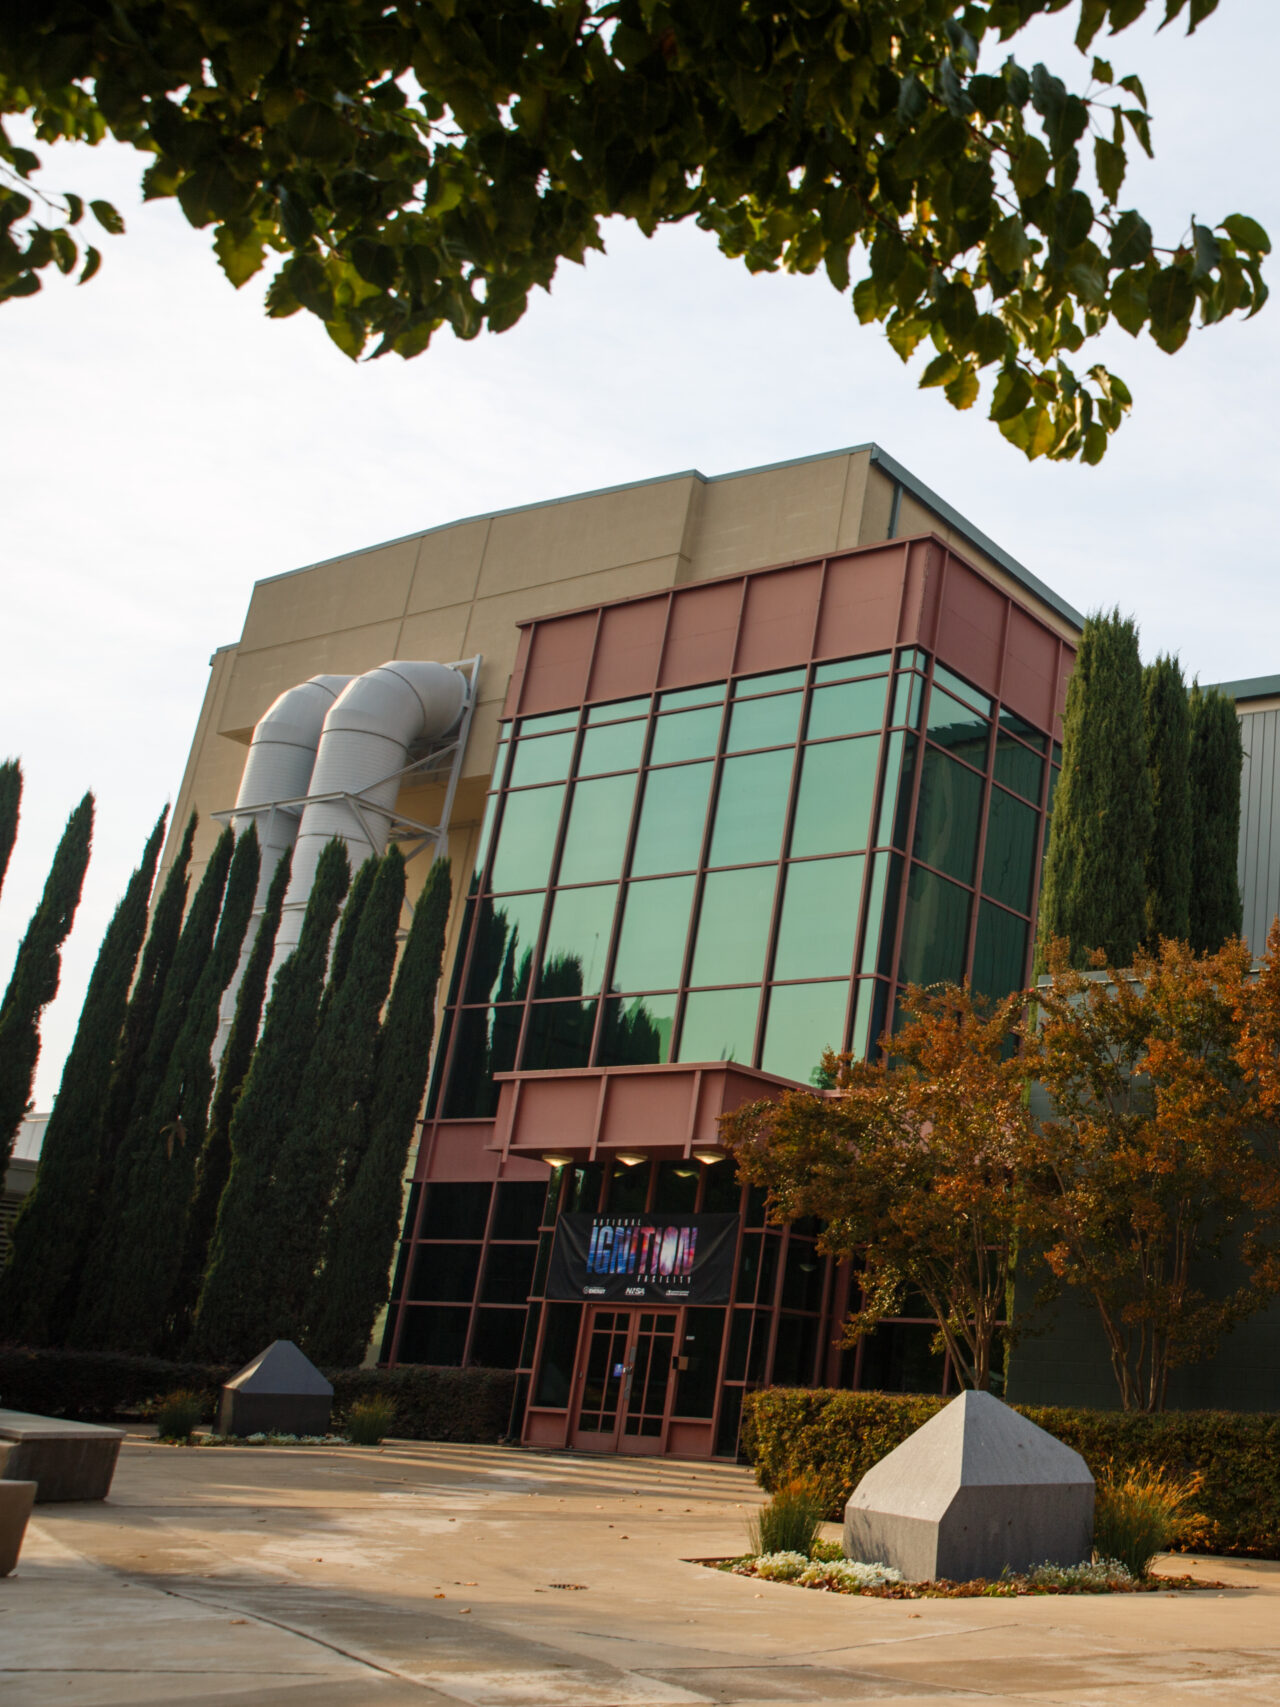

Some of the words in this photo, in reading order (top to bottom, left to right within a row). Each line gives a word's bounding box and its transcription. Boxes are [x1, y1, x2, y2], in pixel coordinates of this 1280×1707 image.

[592, 1218, 641, 1226] NATIONAL
[586, 1225, 698, 1276] IGNITION
[637, 1275, 692, 1284] FACILITY
